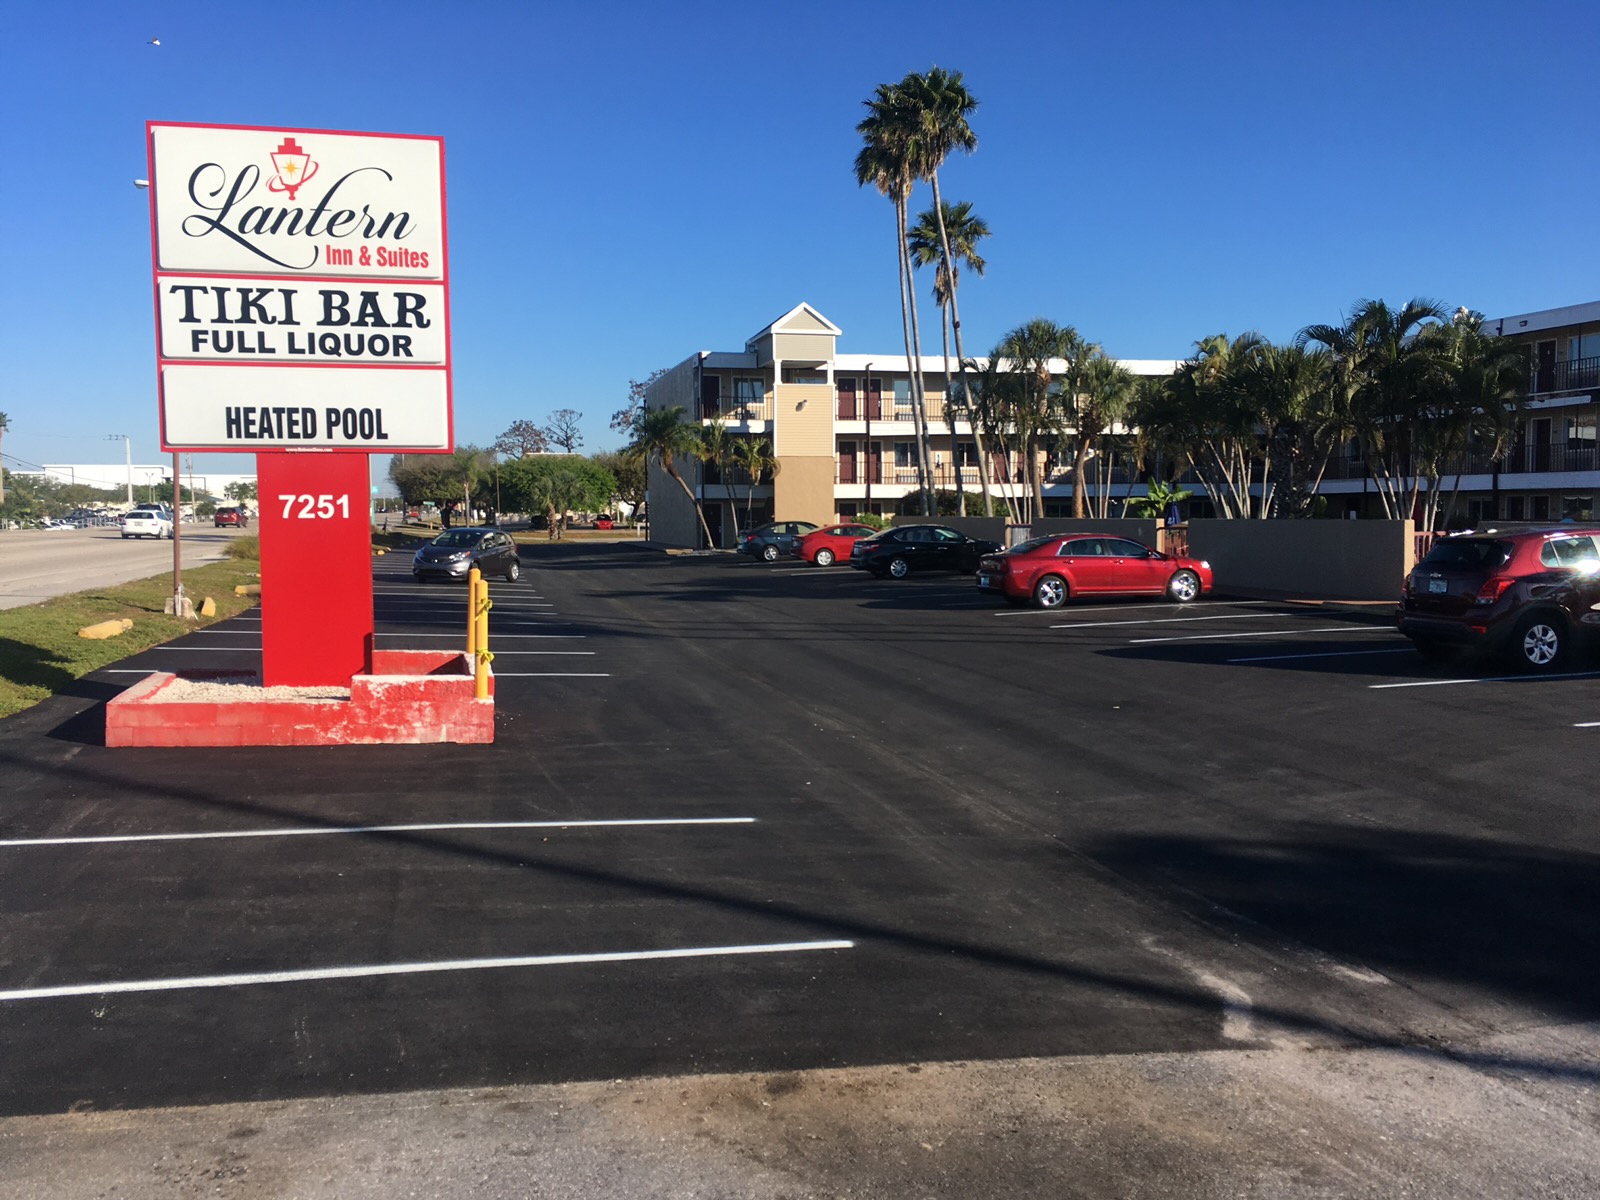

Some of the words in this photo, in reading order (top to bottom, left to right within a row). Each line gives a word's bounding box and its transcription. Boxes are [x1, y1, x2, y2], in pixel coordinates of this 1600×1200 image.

[182, 163, 417, 269] Lantern
[326, 245, 353, 265] Inn
[359, 246, 371, 266] &
[377, 246, 429, 268] Suites
[169, 285, 301, 325] TIKI
[317, 290, 431, 329] BAR
[191, 330, 276, 354] FULL
[288, 332, 413, 357] LIQUOR
[226, 407, 317, 439] HEATED
[326, 408, 388, 440] POOL
[278, 494, 349, 519] 7251
